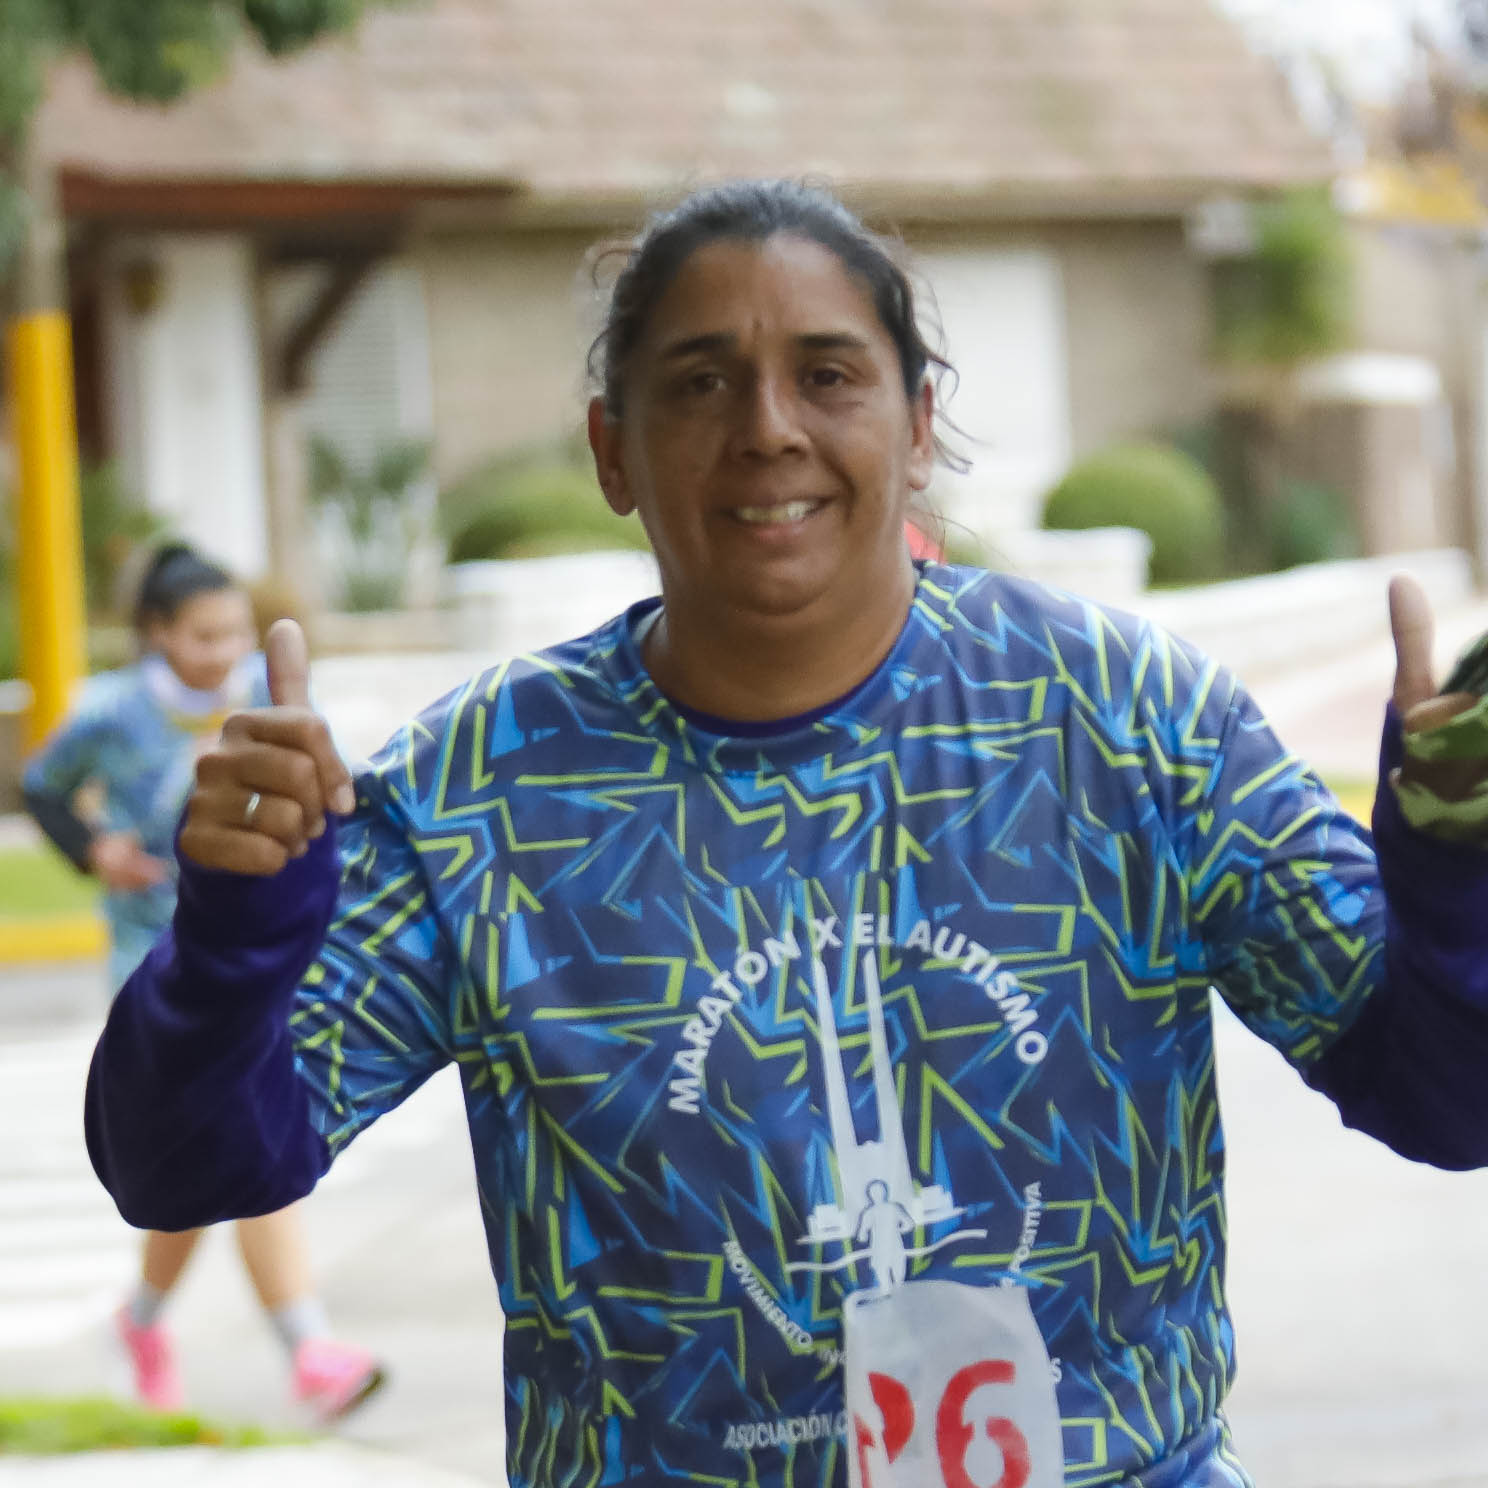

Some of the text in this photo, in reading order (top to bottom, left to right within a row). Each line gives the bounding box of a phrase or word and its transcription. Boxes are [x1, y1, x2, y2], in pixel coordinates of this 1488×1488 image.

[812, 915, 844, 951] X
[854, 912, 896, 946] EL
[905, 918, 1049, 1065] AUTISMO
